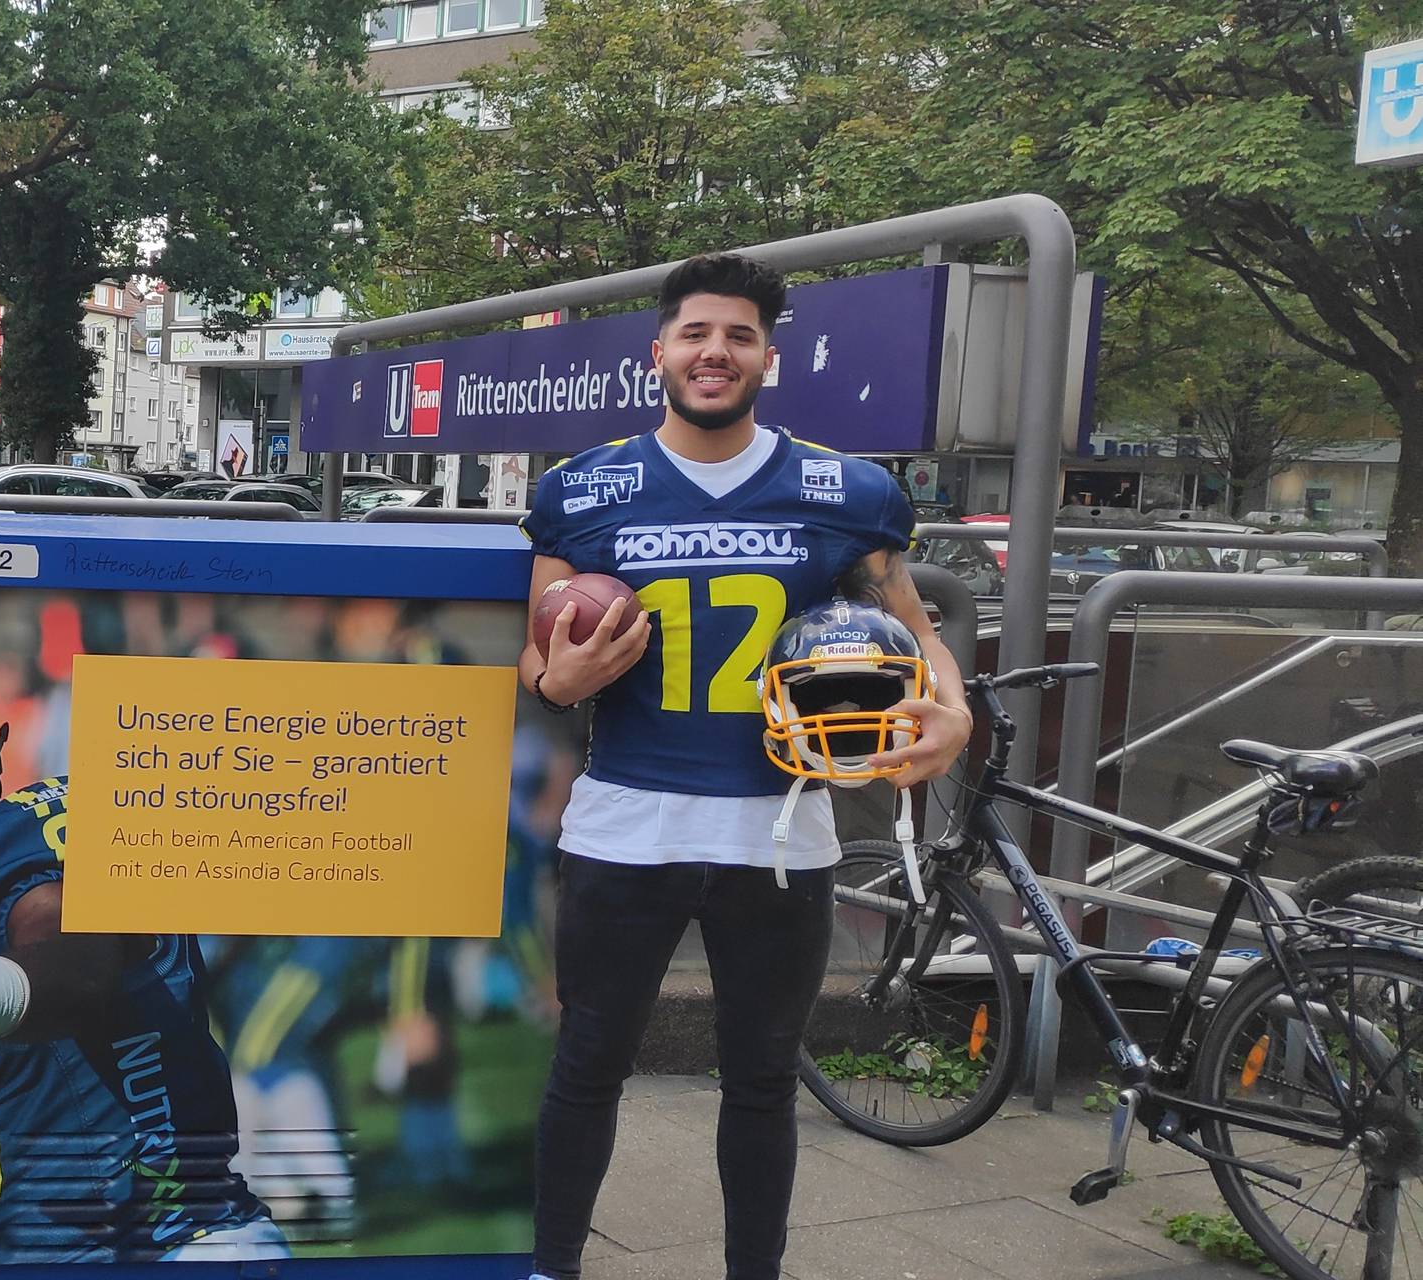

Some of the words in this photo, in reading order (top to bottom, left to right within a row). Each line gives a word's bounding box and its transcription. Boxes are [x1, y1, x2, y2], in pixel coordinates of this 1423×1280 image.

[389, 369, 409, 433] U
[414, 384, 440, 409] Tram
[456, 359, 611, 417] Rüttenscheider
[562, 471, 632, 485] Wartezone
[805, 475, 840, 486] GFL
[615, 526, 791, 561] wohnbau
[0, 550, 13, 570] 2
[636, 574, 786, 713] 12
[820, 631, 870, 641] innogy
[828, 646, 864, 654] Riddell
[118, 704, 215, 732] Unsere
[224, 707, 326, 740] Energie
[336, 711, 467, 743] überträgt
[115, 744, 168, 770] sich
[178, 746, 224, 770] auf
[232, 746, 275, 772] Sie
[312, 750, 449, 780] garantiert
[114, 784, 165, 808] und
[174, 785, 347, 817] störungsfrei!
[111, 827, 163, 847] Auch
[171, 828, 220, 848] beim
[227, 829, 324, 850] American
[331, 831, 413, 851] Football
[109, 859, 142, 878] mit
[150, 860, 187, 879] den
[195, 860, 280, 880] Assindia
[288, 862, 384, 882] Cardinals.
[1026, 882, 1073, 954] PEGASUS
